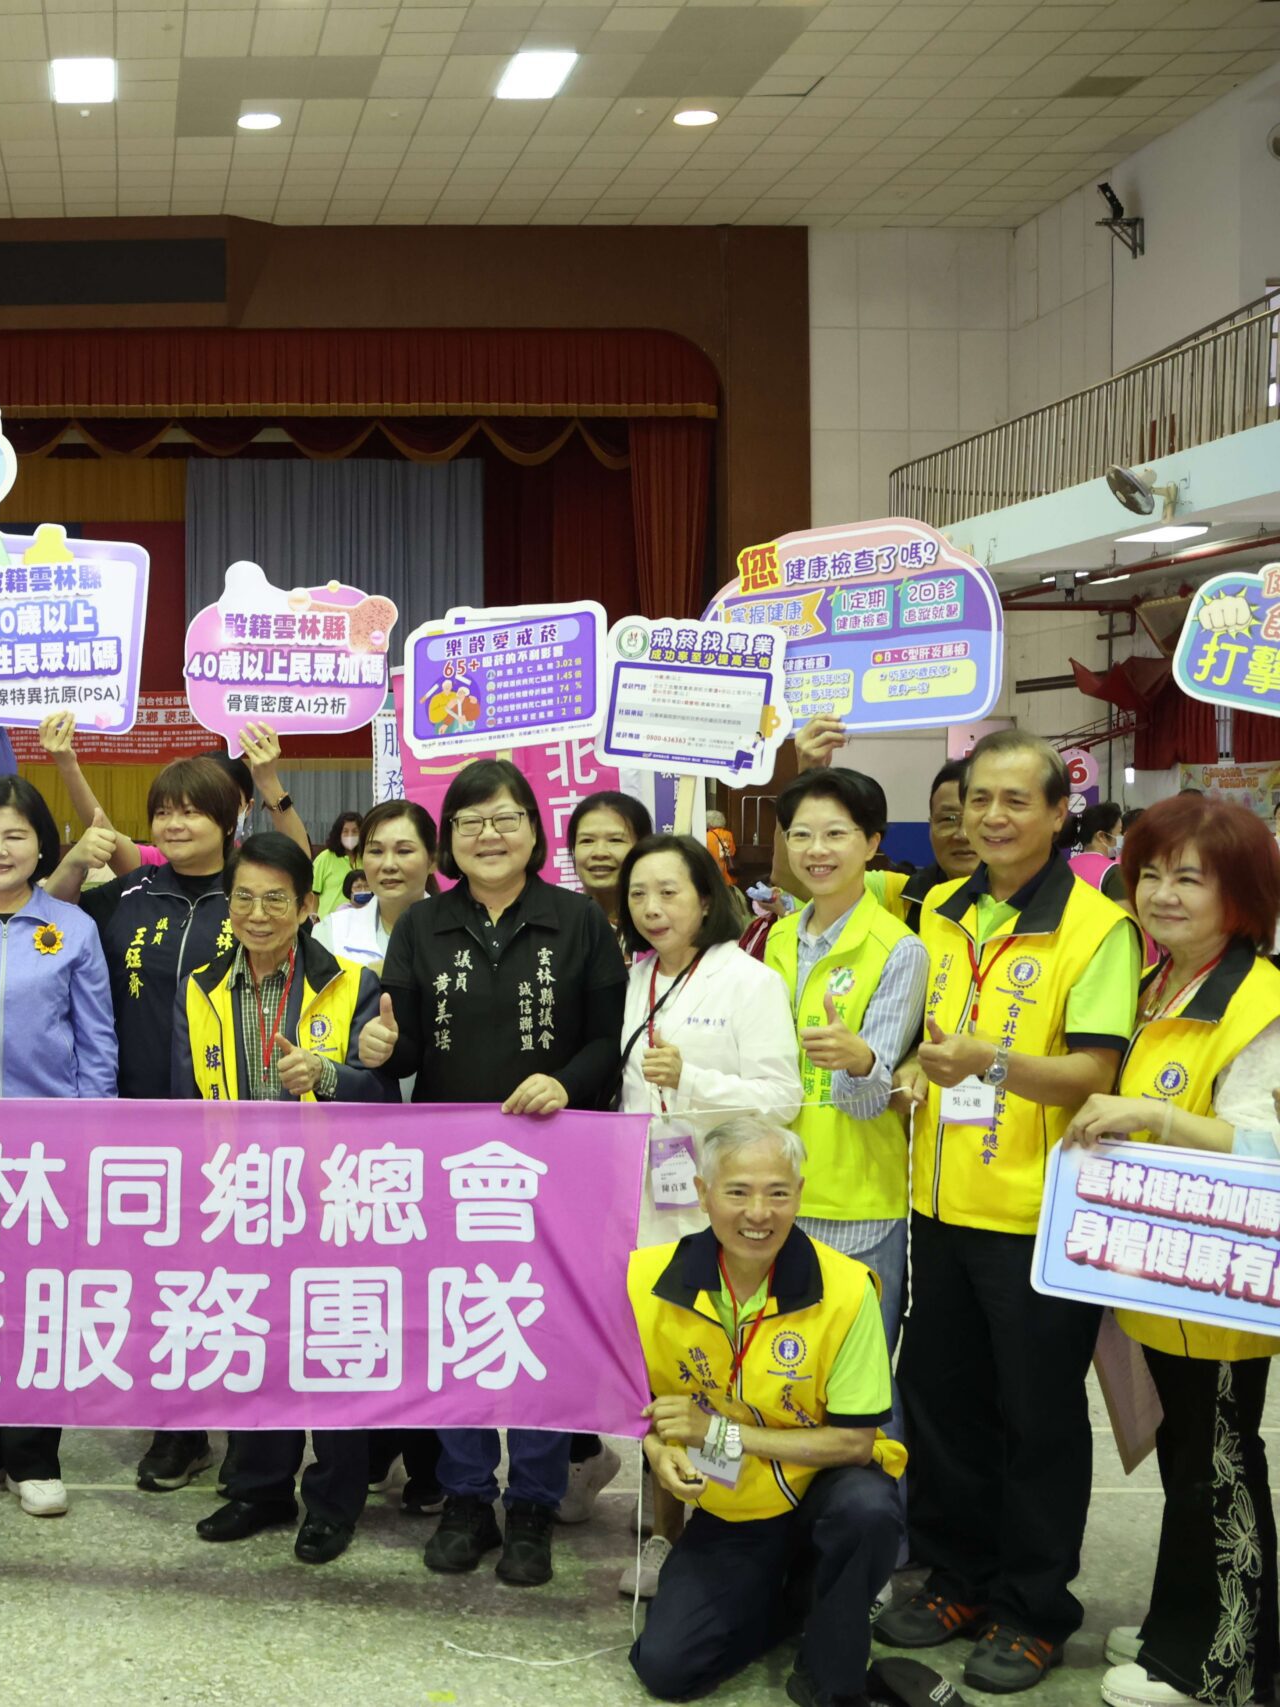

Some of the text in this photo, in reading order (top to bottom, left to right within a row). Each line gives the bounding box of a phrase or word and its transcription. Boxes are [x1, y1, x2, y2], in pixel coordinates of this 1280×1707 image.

[740, 542, 938, 592] 您 健康檢查了嗎?
[908, 580, 956, 602] 2回診
[730, 601, 803, 624] 掌握健康
[835, 612, 889, 631] 健康檢查
[904, 603, 960, 623] 追蹤就醫
[225, 613, 346, 641] 設籍雲林縣
[446, 624, 558, 658] 樂齡愛戒菸
[651, 628, 775, 656] 戒菸找專業
[187, 650, 385, 685] 40歲以上民眾加碼
[443, 658, 480, 678] 65+
[650, 649, 771, 669] 成功率至少提高三倍
[227, 695, 347, 715] 骨質密度AI分析
[151, 917, 168, 945] 議員
[216, 918, 234, 958] 雲林
[454, 949, 473, 992] 議員
[536, 947, 556, 1050] 雲林縣議會
[519, 981, 534, 1051] 誠信聯盟
[1065, 1210, 1280, 1301] 身體健康有
